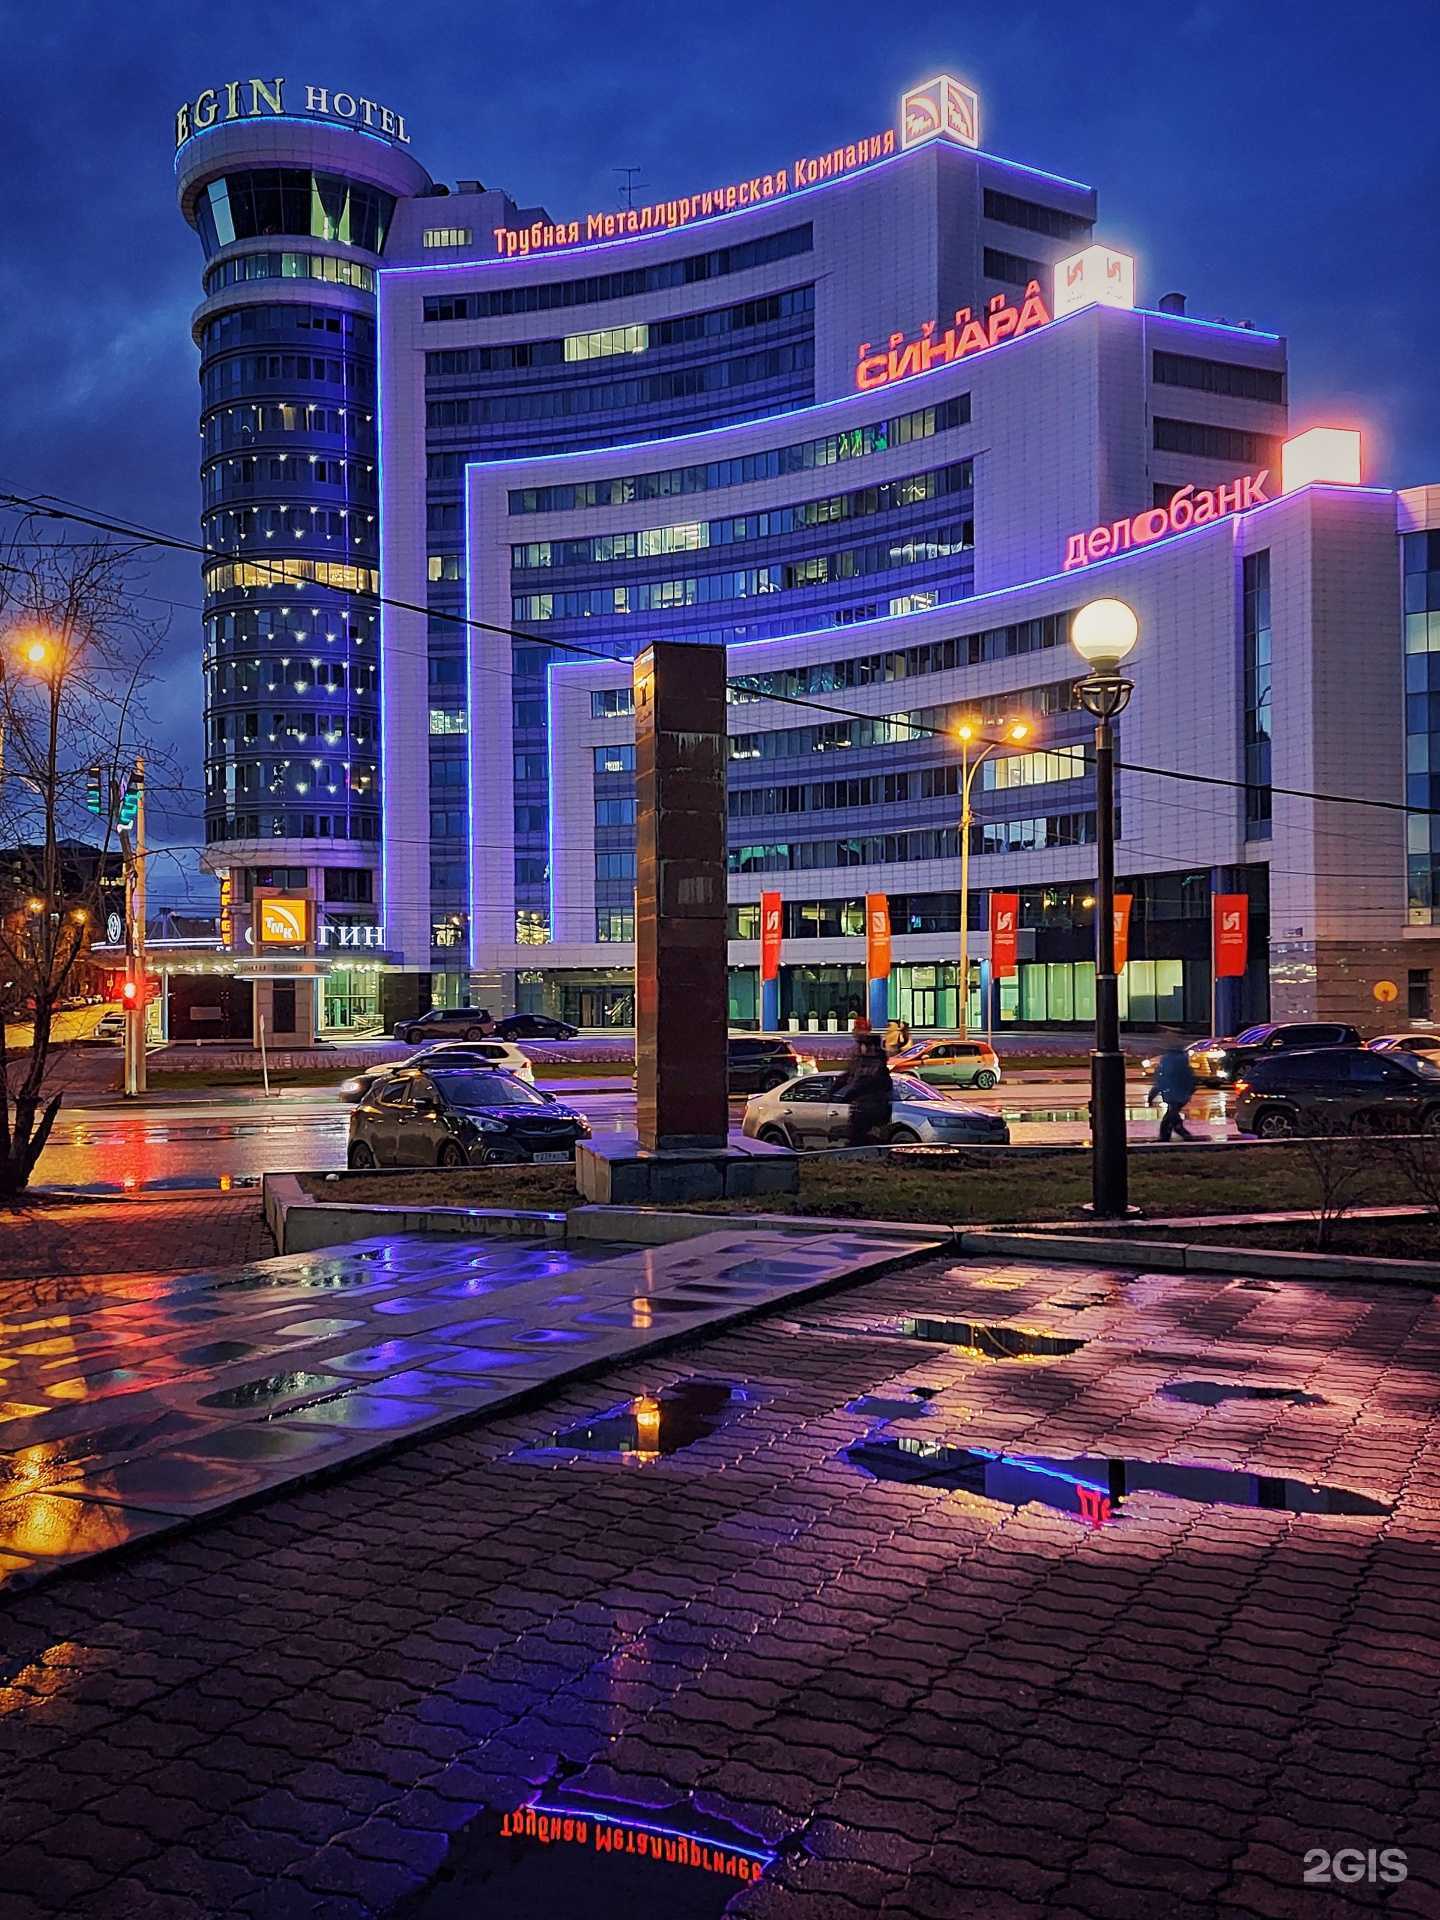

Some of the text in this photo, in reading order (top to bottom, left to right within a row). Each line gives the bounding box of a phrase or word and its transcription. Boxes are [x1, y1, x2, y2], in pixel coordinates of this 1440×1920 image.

[175, 77, 411, 148] EGIN HOTEL
[493, 128, 895, 257] Трубная Металлургическая Компания
[856, 295, 1051, 390] СИНАРА
[265, 916, 294, 939] ТМК
